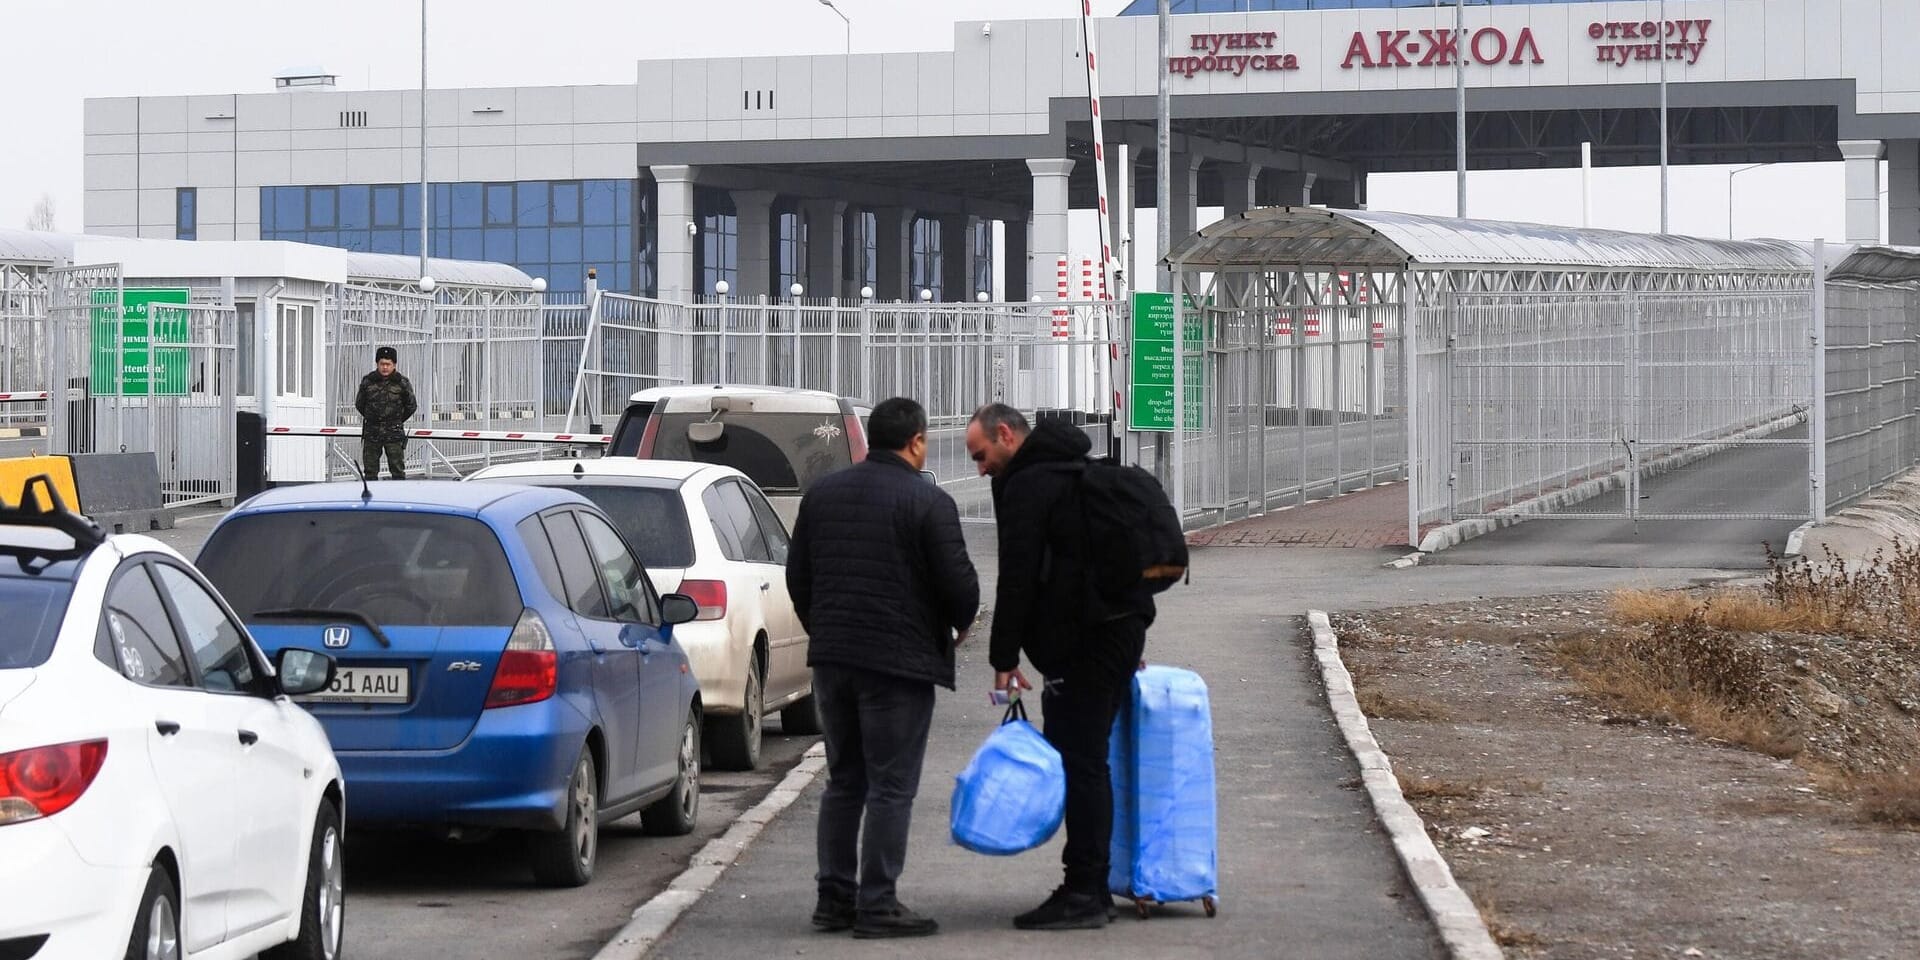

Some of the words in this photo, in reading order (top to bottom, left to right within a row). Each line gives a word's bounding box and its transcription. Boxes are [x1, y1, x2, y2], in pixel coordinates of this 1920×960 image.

[1190, 32, 1277, 55] пункт
[1340, 27, 1544, 68] АК-ЖОЛ
[1169, 54, 1299, 78] пропуска
[119, 364, 165, 373] ttentin!
[448, 660, 482, 671] Fit
[361, 674, 399, 694] AAU
